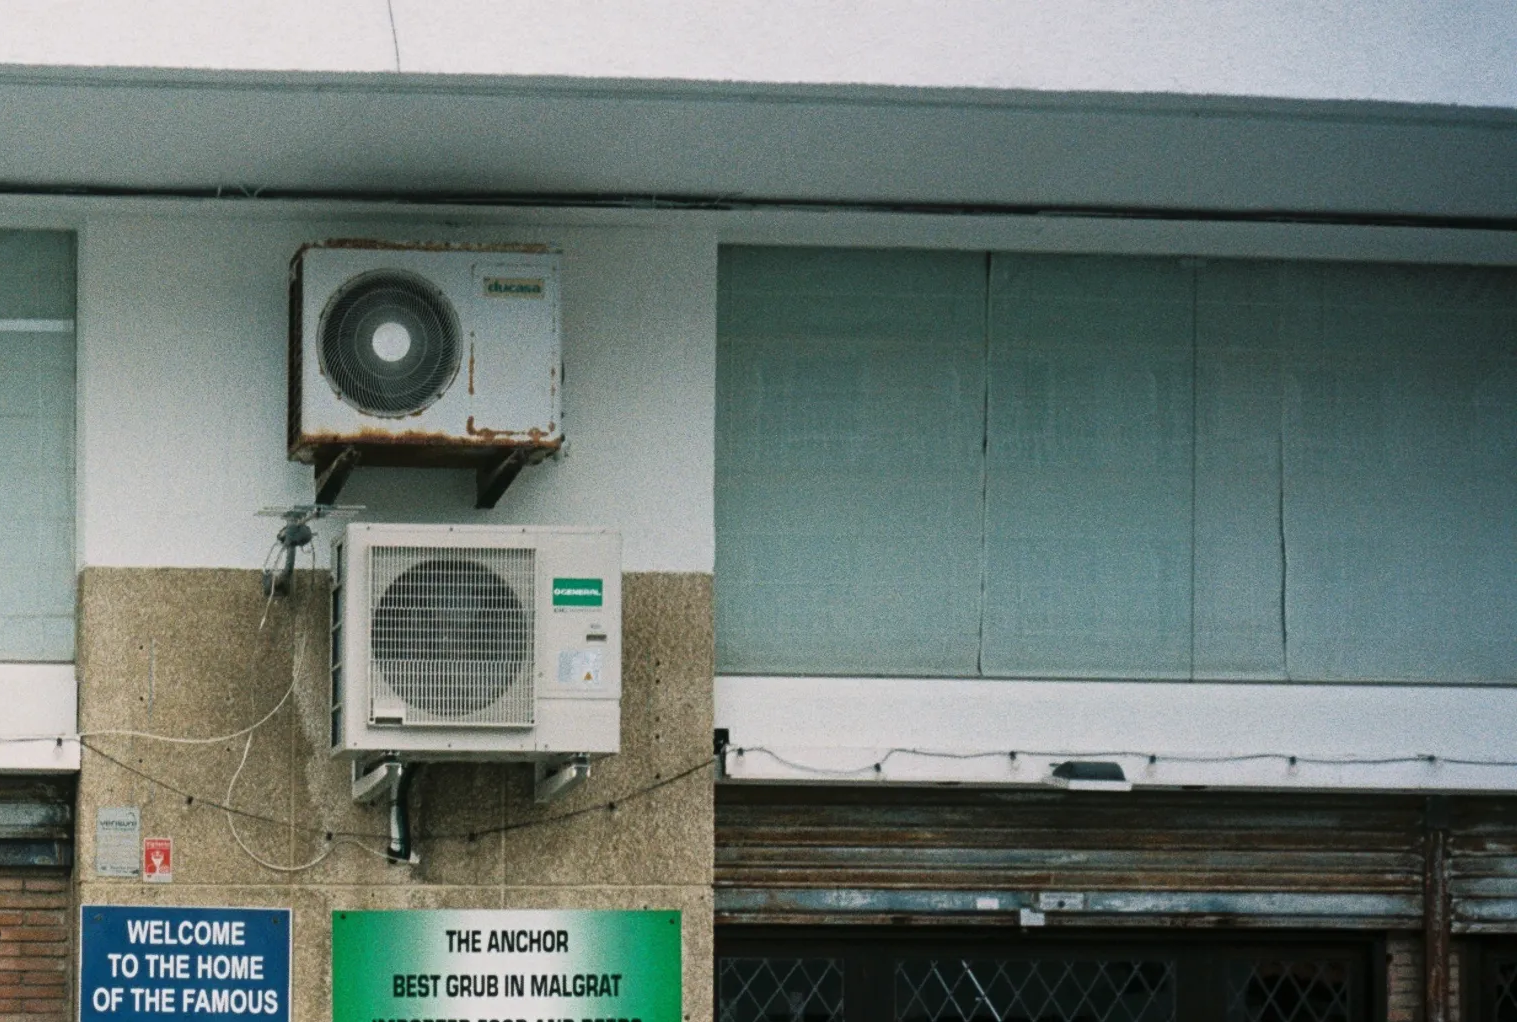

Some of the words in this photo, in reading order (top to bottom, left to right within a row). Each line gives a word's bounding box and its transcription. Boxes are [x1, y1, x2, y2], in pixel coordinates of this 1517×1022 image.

[127, 920, 245, 945] WELCOME
[446, 930, 482, 952] THE
[487, 930, 569, 952] ANCHOR
[108, 954, 139, 979] TO
[145, 954, 190, 979] THE
[197, 955, 264, 980] HOME
[393, 975, 441, 997] BEST
[446, 975, 499, 997] GRUB
[504, 975, 524, 997] IN
[530, 974, 622, 997] MALGRAT
[93, 987, 124, 1012] OF
[131, 988, 176, 1013] THE
[182, 989, 278, 1014] FAMOUS
